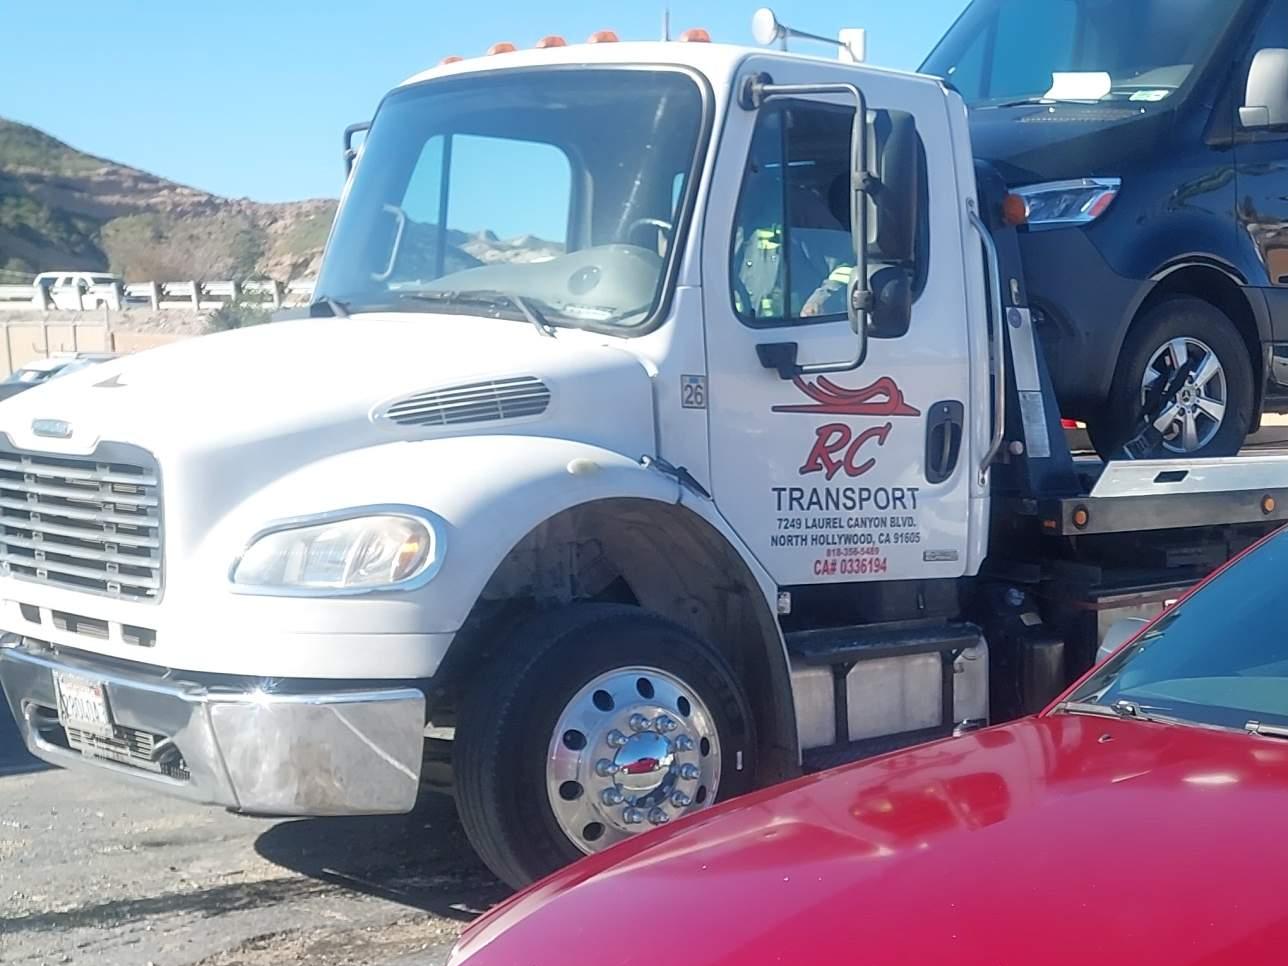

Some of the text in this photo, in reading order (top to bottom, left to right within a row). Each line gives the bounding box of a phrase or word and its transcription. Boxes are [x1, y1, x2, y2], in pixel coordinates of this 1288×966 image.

[684, 384, 703, 405] 26
[799, 422, 892, 481] RC
[772, 488, 920, 511] TRANSPORT
[777, 517, 916, 530] 7249 LAUREL CANYON BLVD.
[771, 535, 808, 546] NORTH
[811, 534, 875, 546] HOLLYWOOD,
[878, 533, 891, 544] CA
[814, 558, 887, 575] CA# 0336194
